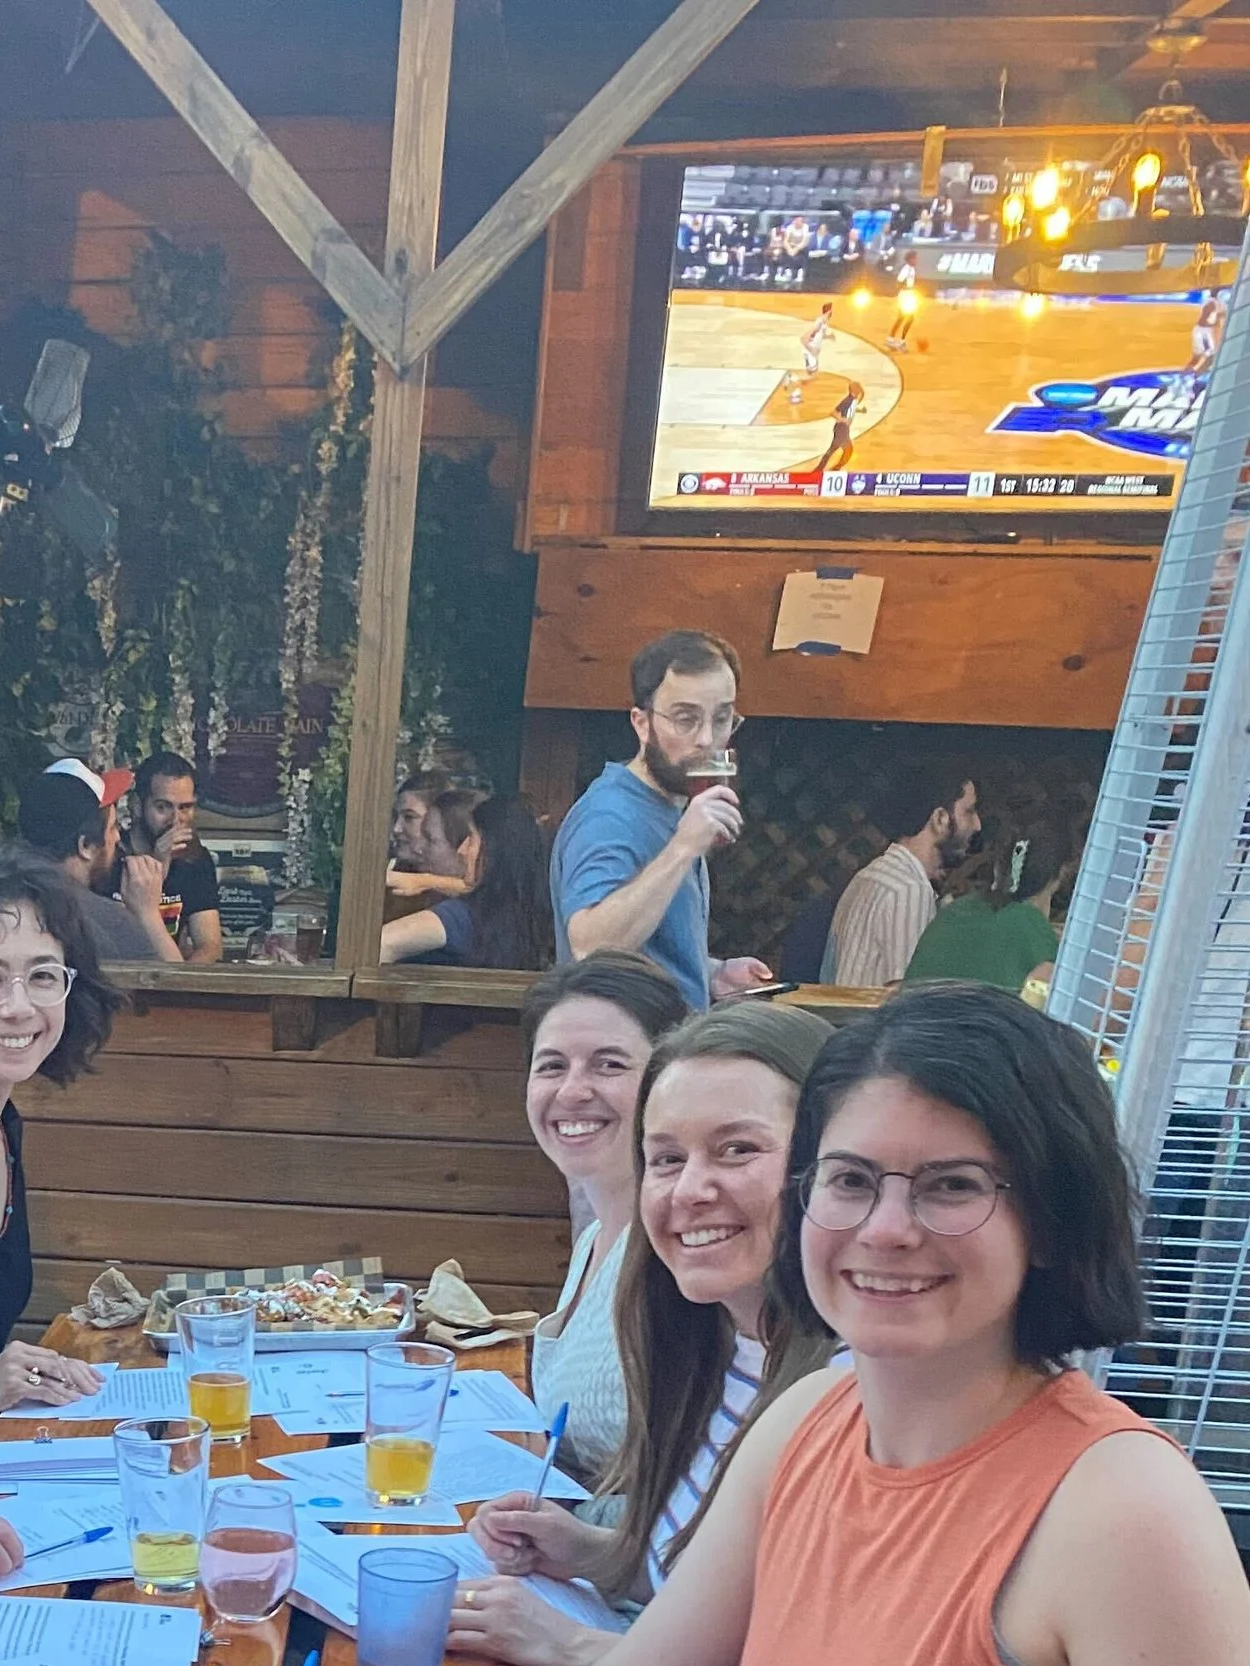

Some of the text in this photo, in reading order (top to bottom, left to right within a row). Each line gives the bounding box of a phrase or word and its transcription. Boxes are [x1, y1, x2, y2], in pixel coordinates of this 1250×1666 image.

[741, 472, 789, 483] ARKANSAS
[827, 476, 844, 491] 10
[886, 473, 921, 484] UCONN
[974, 476, 990, 492] 11
